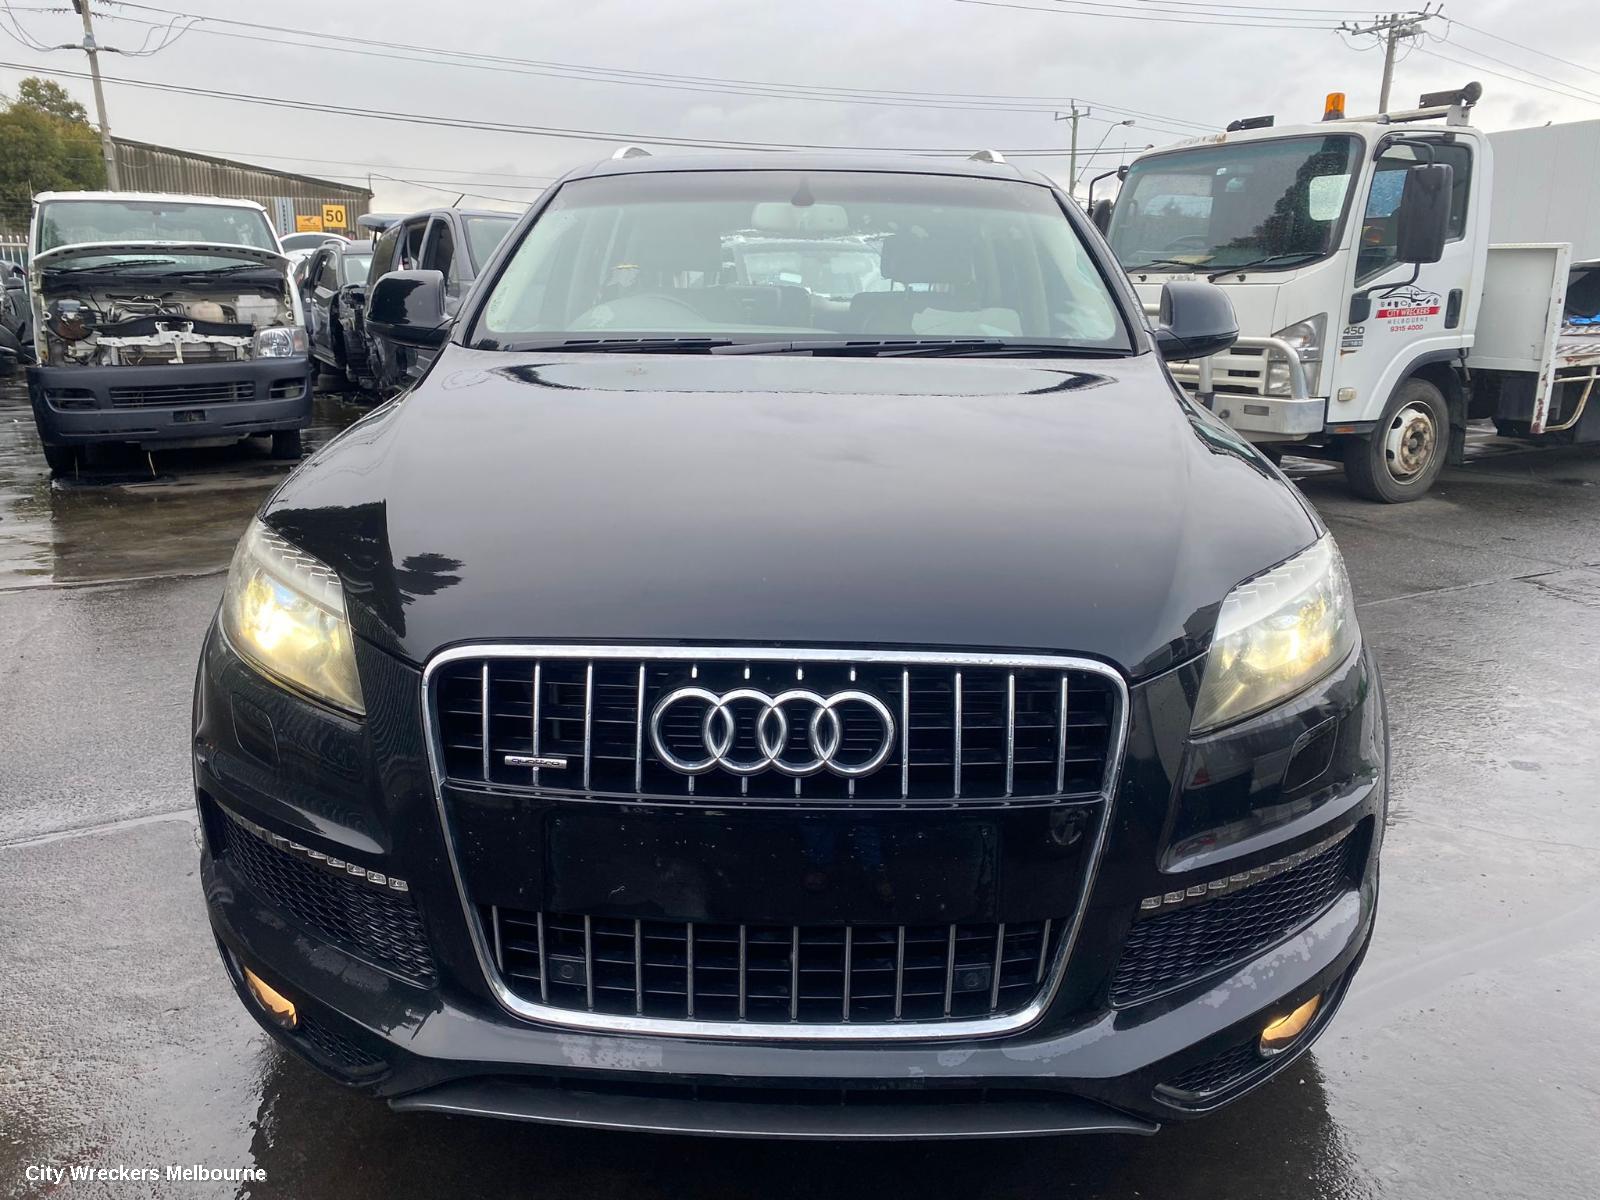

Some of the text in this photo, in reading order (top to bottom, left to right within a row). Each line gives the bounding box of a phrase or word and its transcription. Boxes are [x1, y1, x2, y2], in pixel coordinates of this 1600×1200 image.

[326, 210, 343, 222] 50
[1401, 307, 1430, 316] WRECKERS
[1343, 326, 1365, 335] 450
[511, 758, 560, 766] quattro
